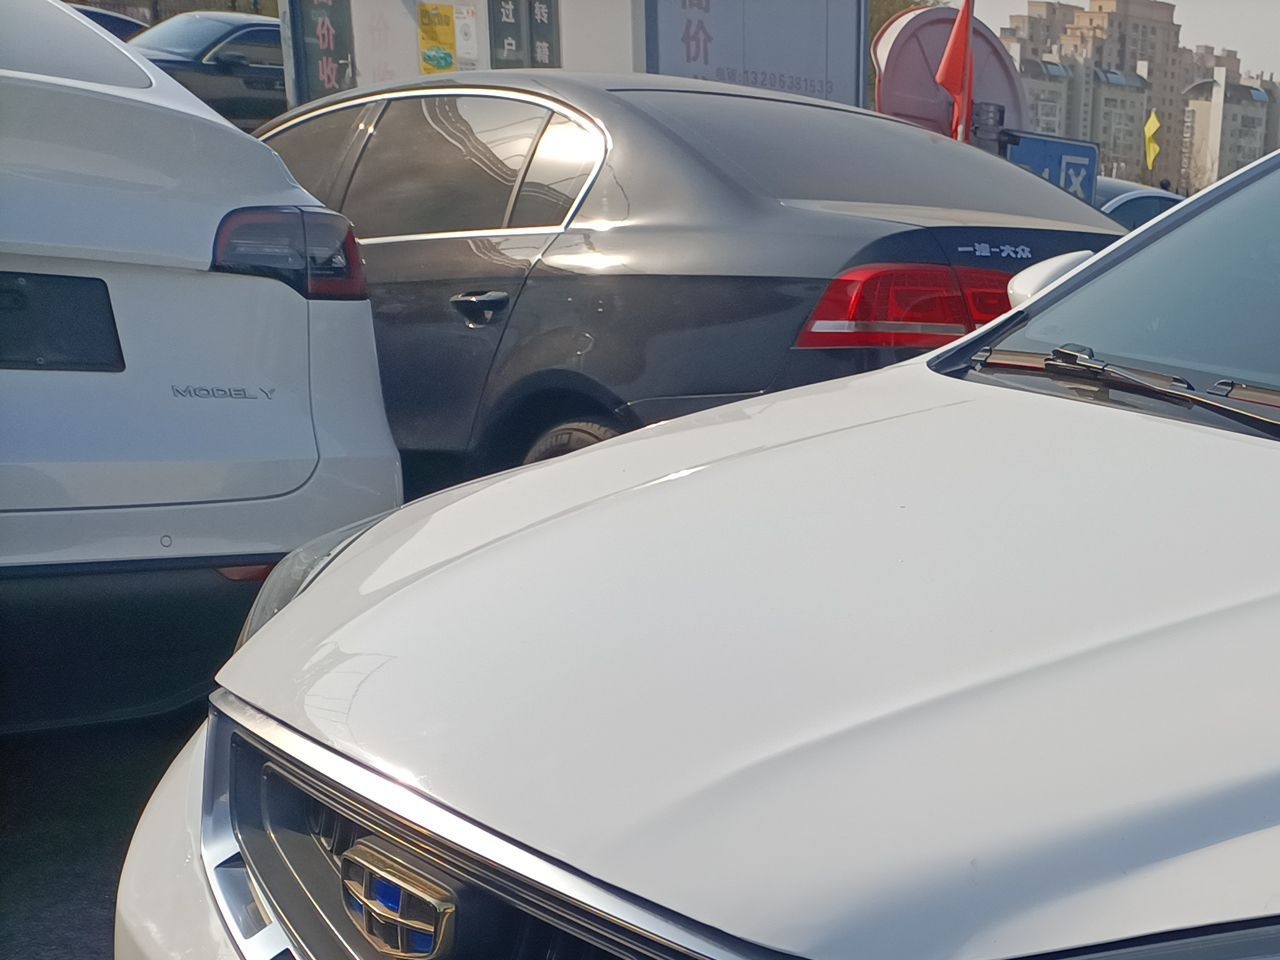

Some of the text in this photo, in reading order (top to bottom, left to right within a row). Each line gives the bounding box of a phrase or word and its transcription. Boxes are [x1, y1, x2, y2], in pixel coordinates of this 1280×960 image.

[314, 0, 338, 89] 价收
[500, 0, 516, 58] 过户
[533, 1, 550, 64] 转籍
[170, 384, 276, 400] MODEL Y
